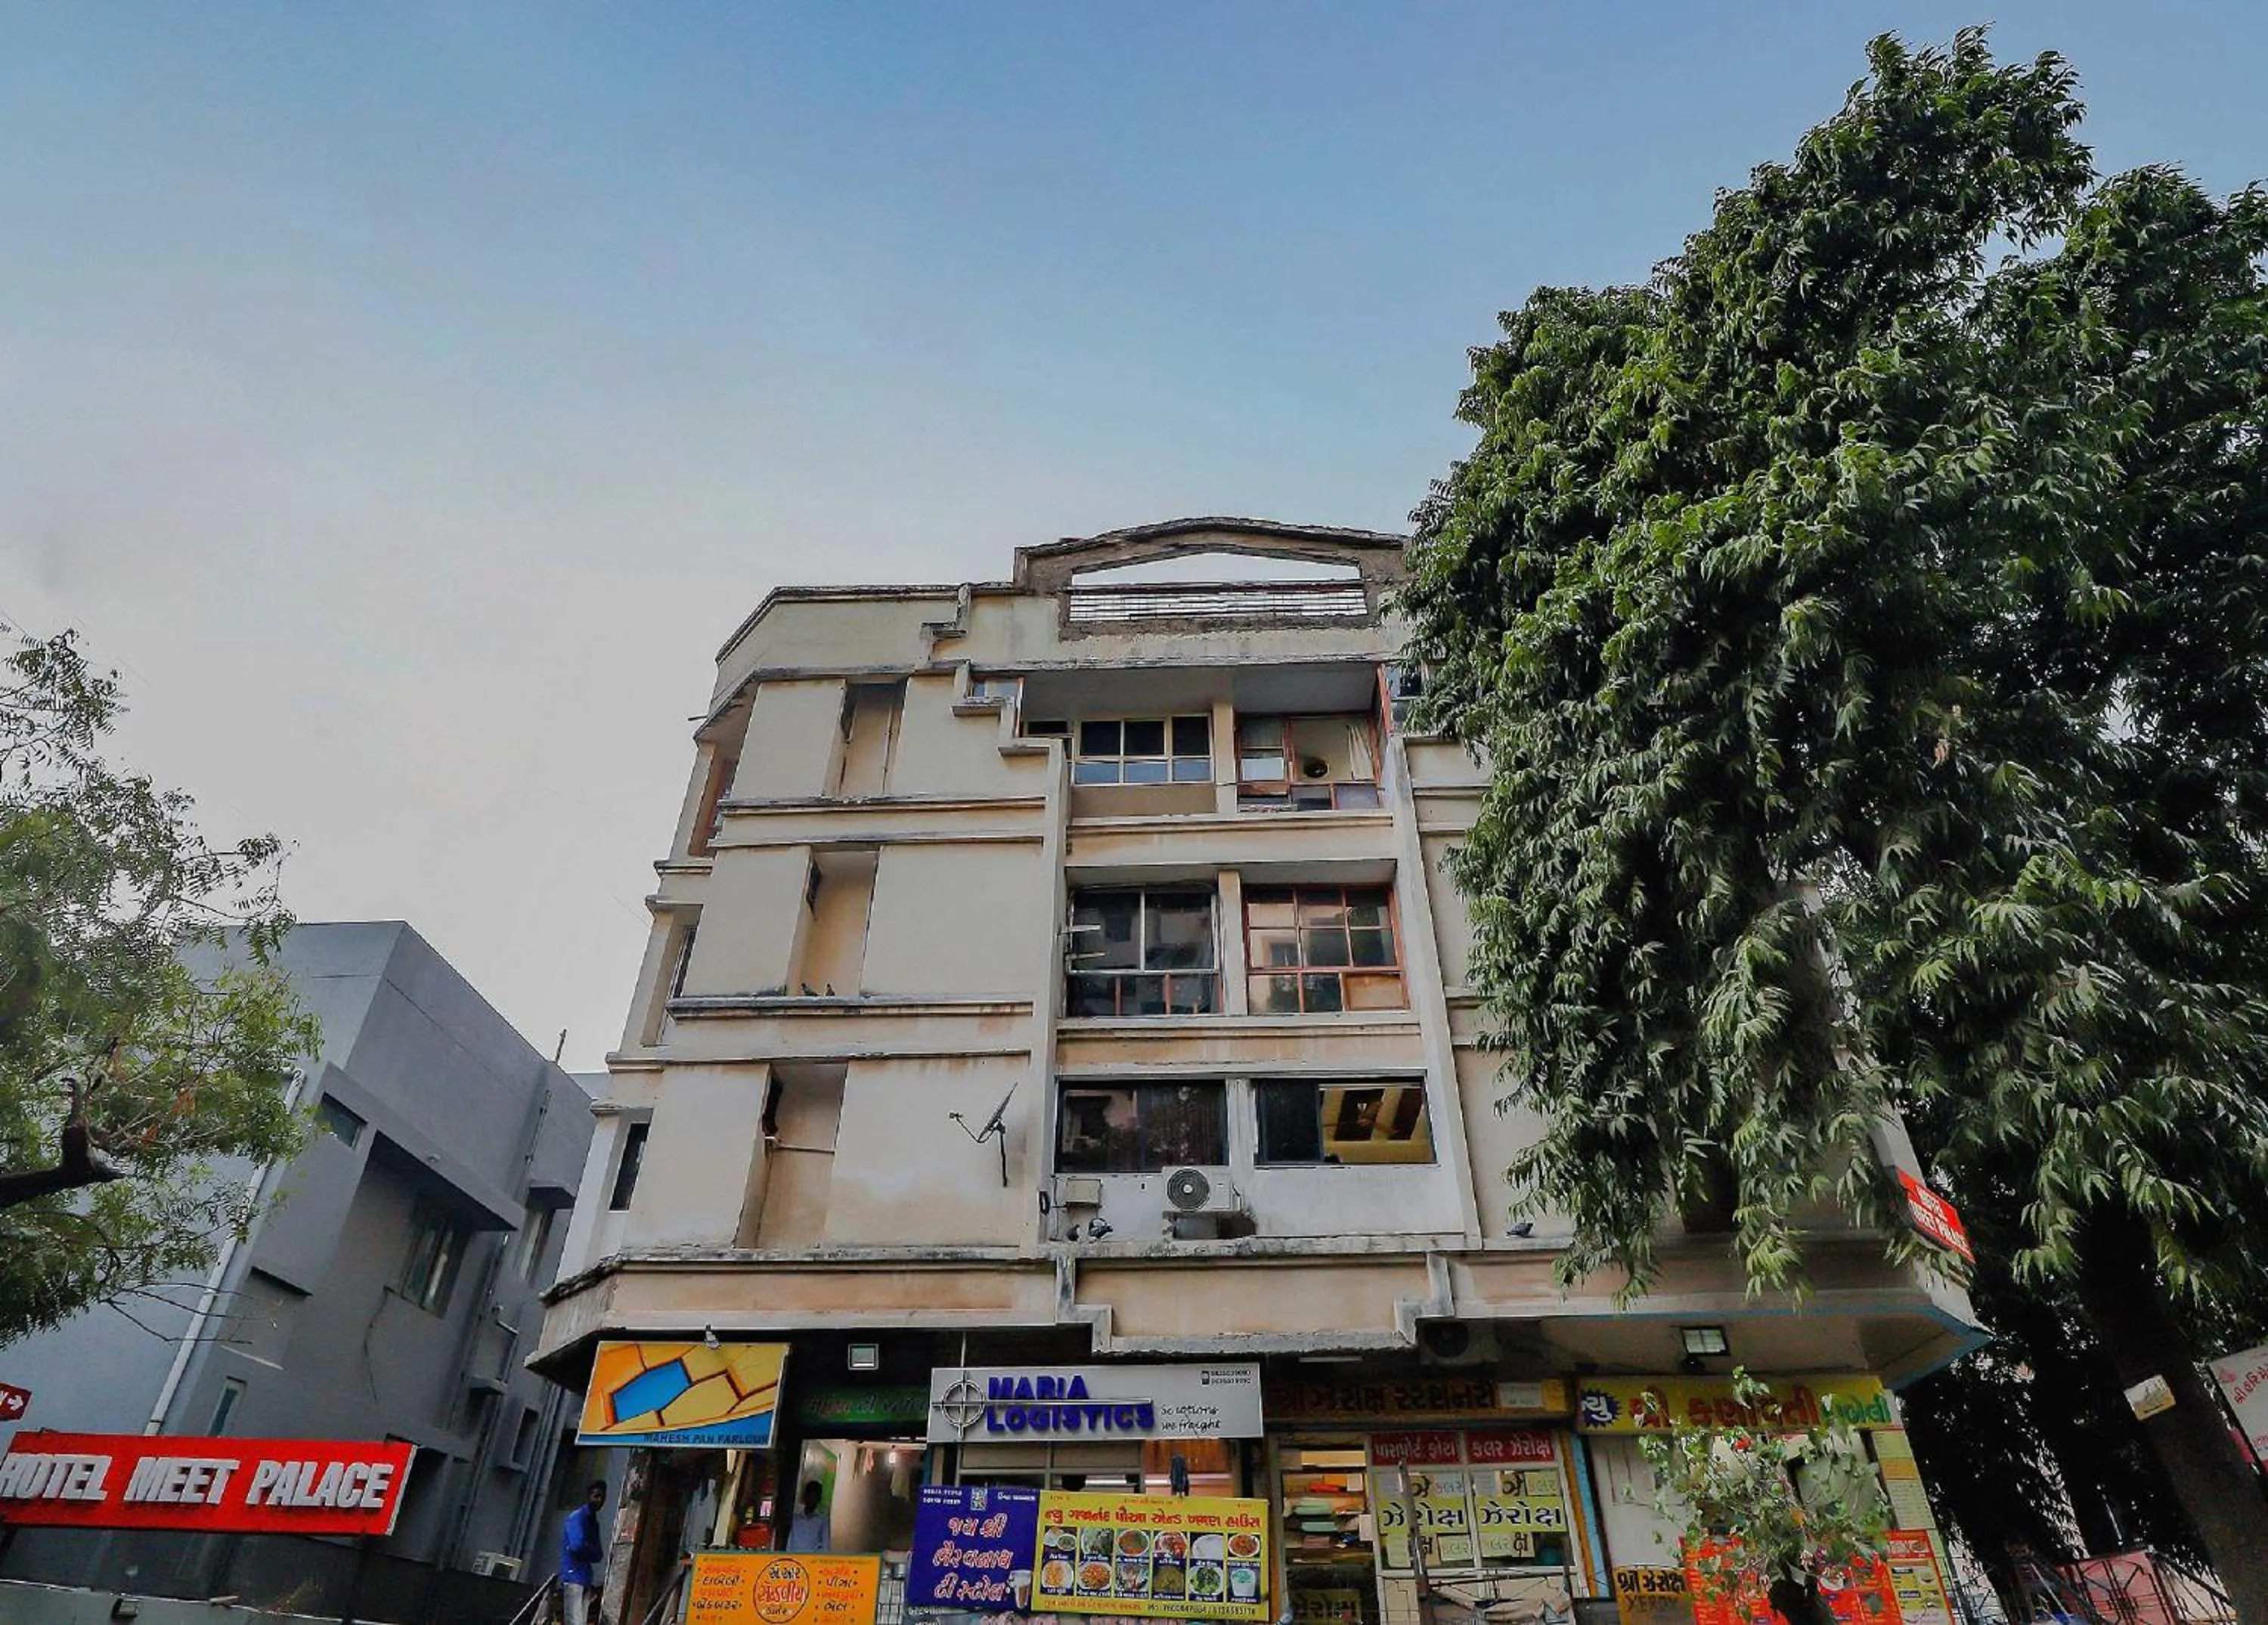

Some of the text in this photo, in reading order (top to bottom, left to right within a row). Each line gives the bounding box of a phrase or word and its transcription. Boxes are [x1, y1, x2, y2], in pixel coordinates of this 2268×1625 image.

[988, 1375, 1089, 1400] MARIA
[986, 1403, 1155, 1432] LOGISTICS
[0, 1453, 395, 1509] HOTEL MEET PALACE
[1481, 1500, 1561, 1528] ઝેરોક્ષ
